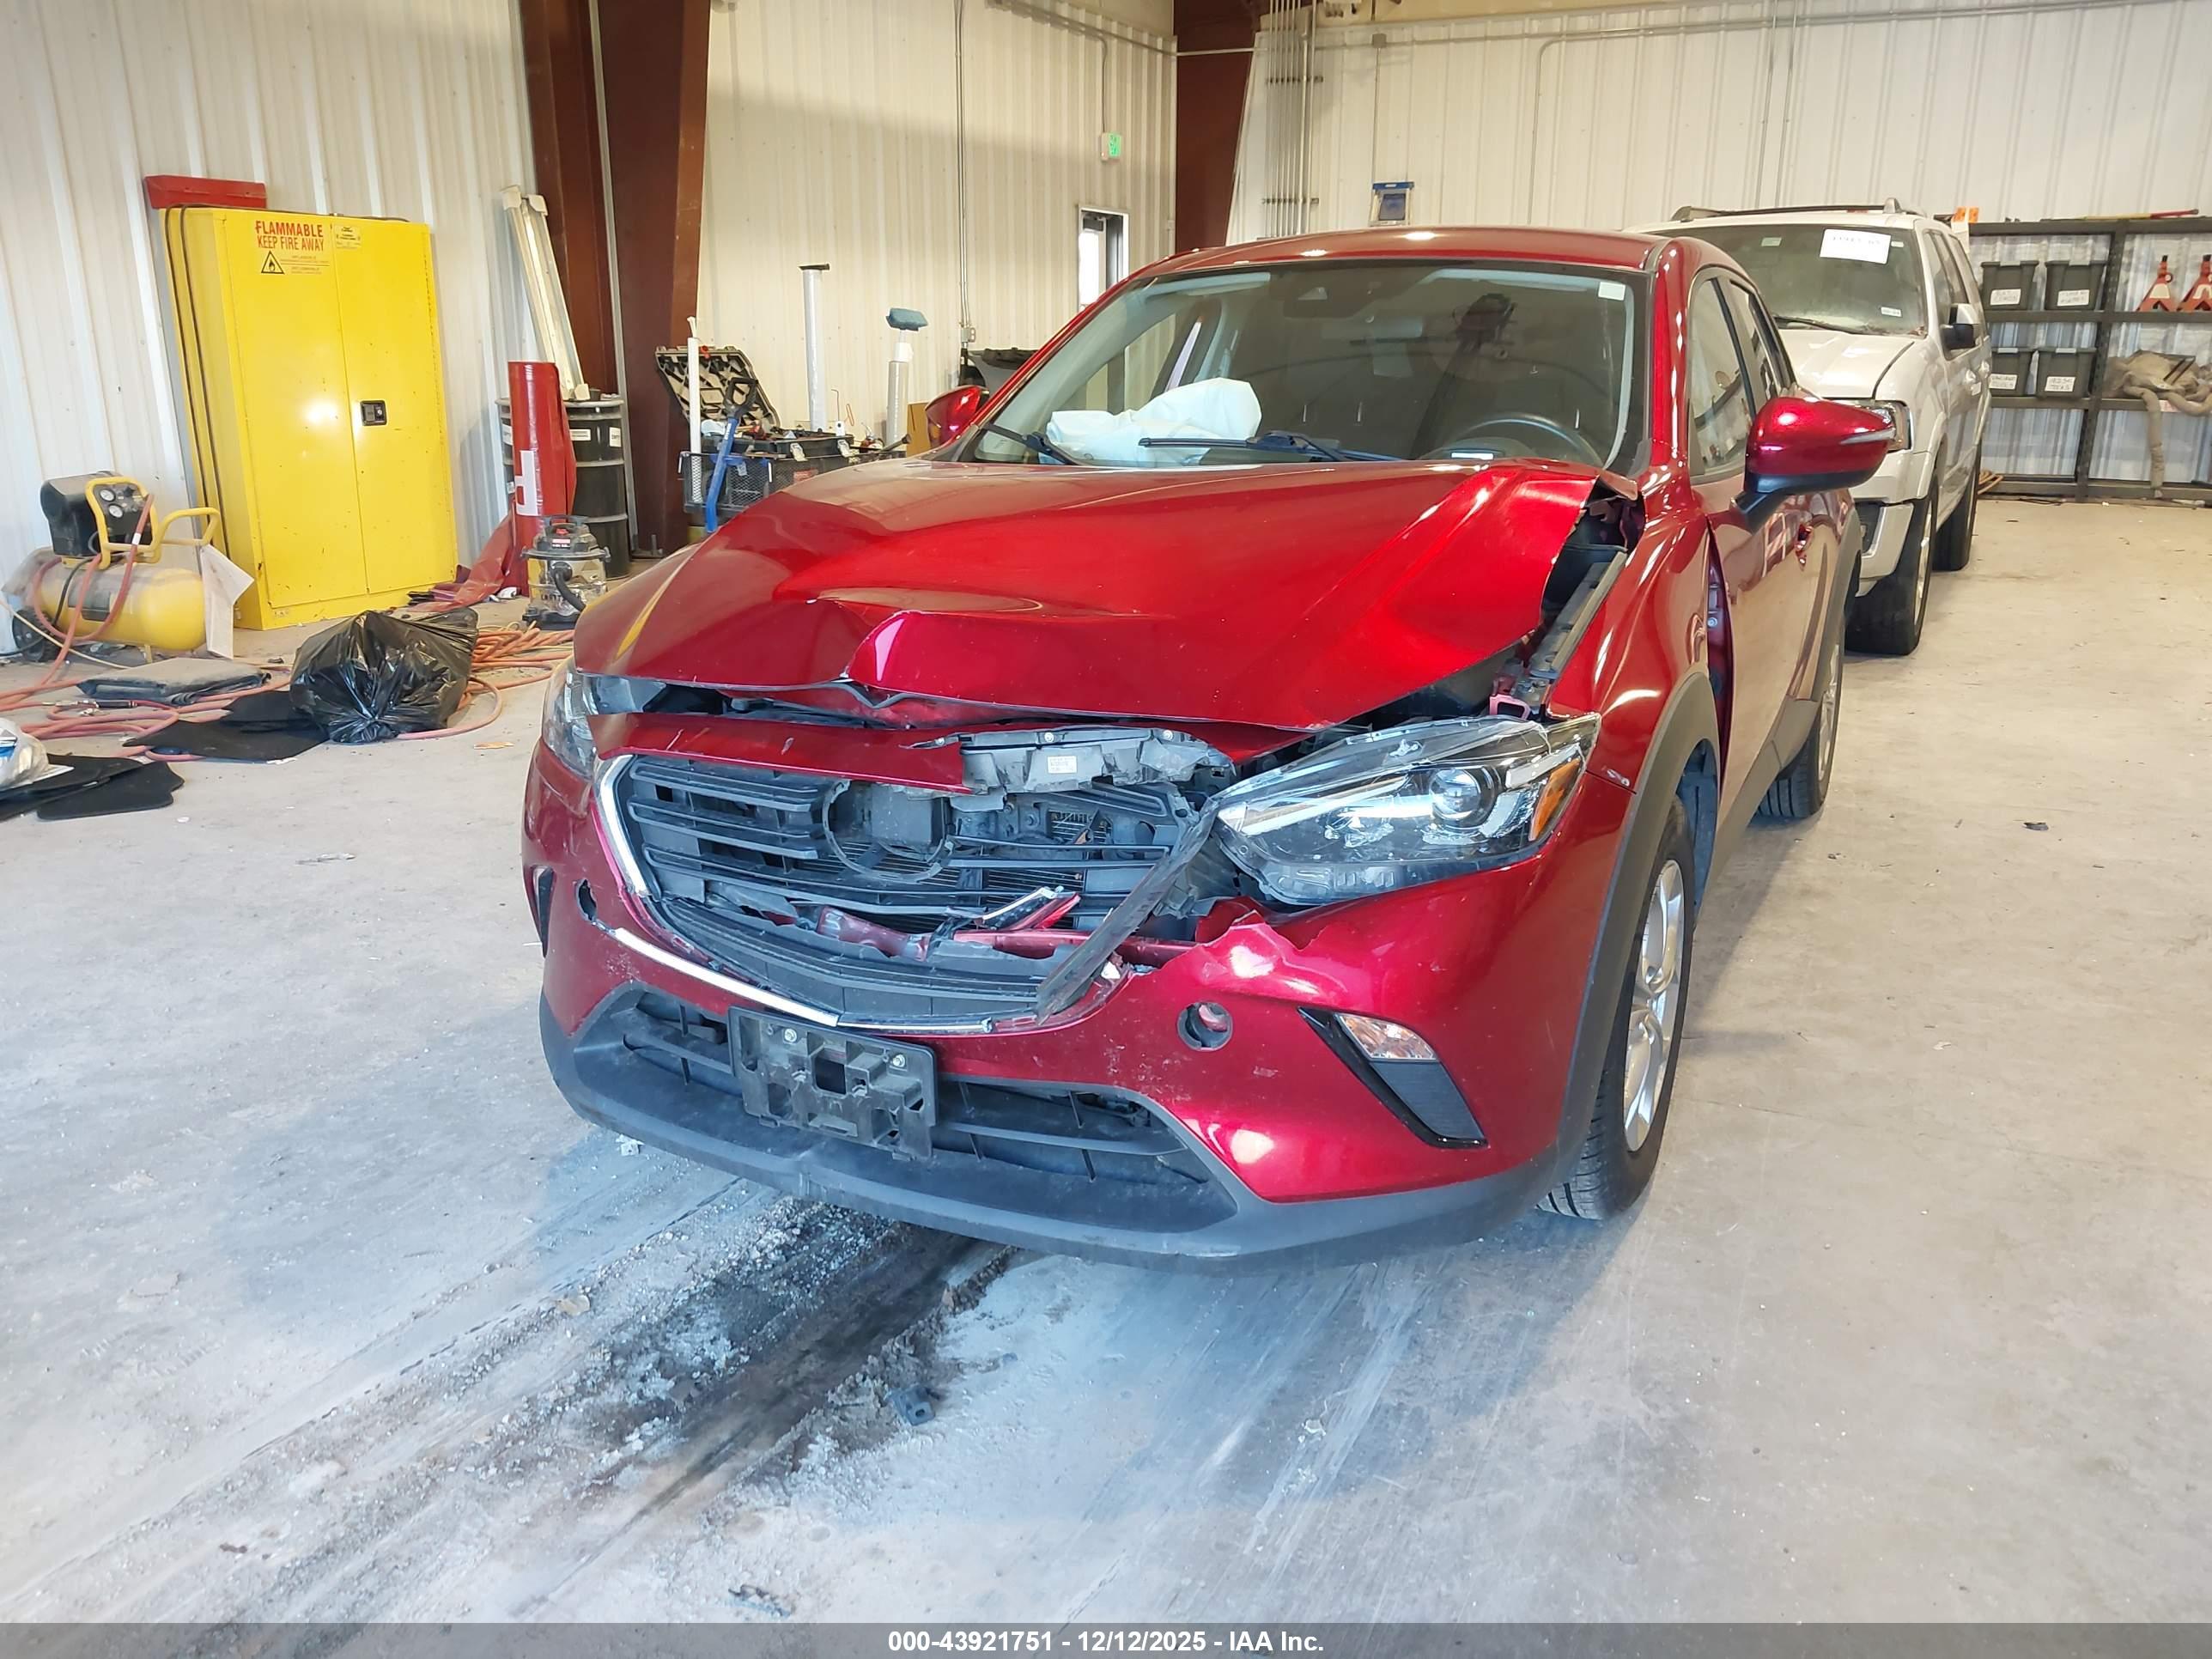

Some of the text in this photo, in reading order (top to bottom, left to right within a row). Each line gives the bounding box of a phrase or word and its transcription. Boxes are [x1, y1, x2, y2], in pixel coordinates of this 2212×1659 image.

[255, 220, 324, 238] FLAMMABLE
[257, 235, 277, 249] KEEP
[280, 236, 299, 251] FIRE
[301, 237, 324, 252] AWAY
